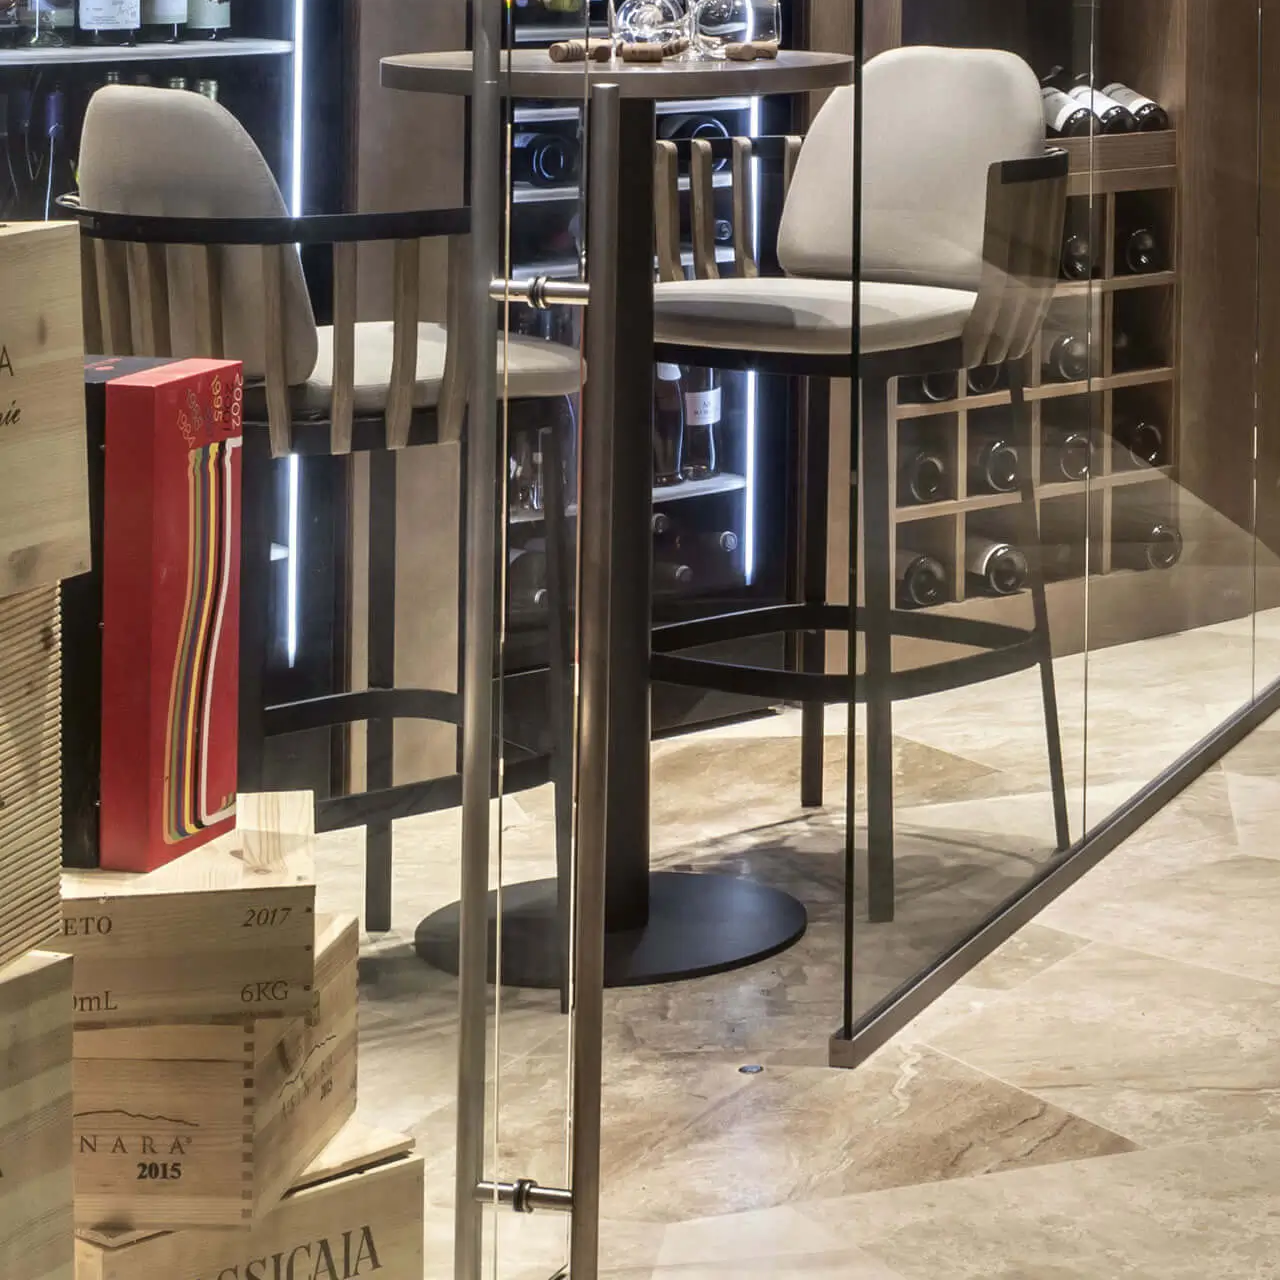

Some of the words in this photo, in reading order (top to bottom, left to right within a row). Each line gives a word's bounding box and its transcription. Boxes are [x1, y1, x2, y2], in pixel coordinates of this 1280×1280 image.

[63, 916, 113, 937] ETO
[241, 907, 293, 928] 2017
[73, 990, 118, 1012] mL
[240, 980, 289, 1003] 6KG
[136, 1162, 183, 1180] 2015
